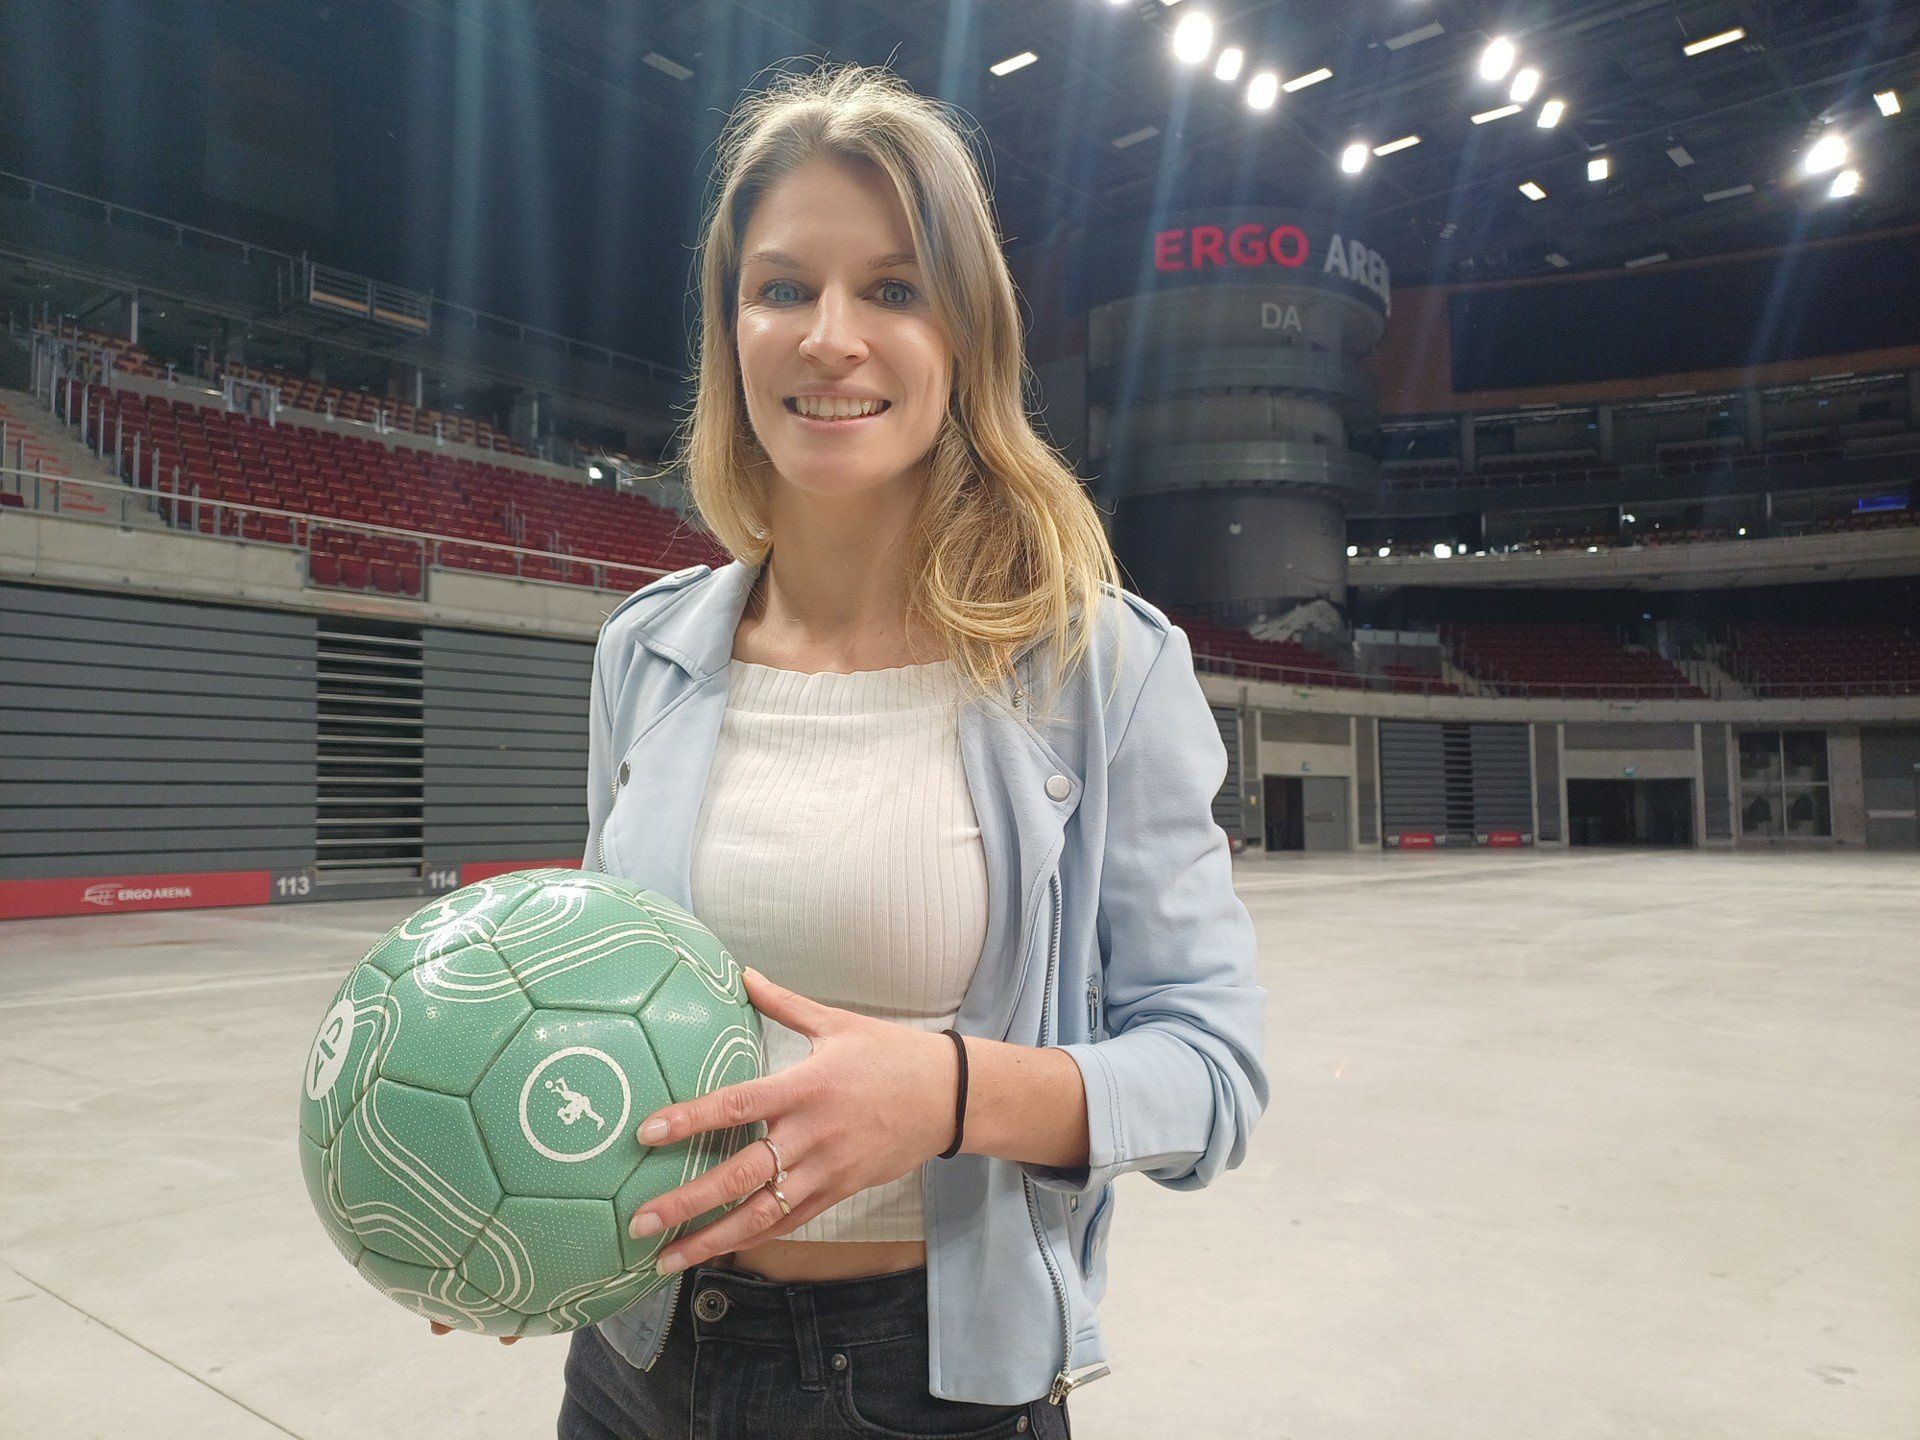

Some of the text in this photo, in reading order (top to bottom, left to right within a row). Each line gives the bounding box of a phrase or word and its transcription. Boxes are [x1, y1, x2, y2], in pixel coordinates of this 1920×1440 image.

[1154, 223, 1310, 273] ERGO
[1261, 302, 1302, 331] DA
[275, 875, 310, 896] 113
[428, 870, 457, 889] 114
[118, 887, 192, 901] ERGO ARENA
